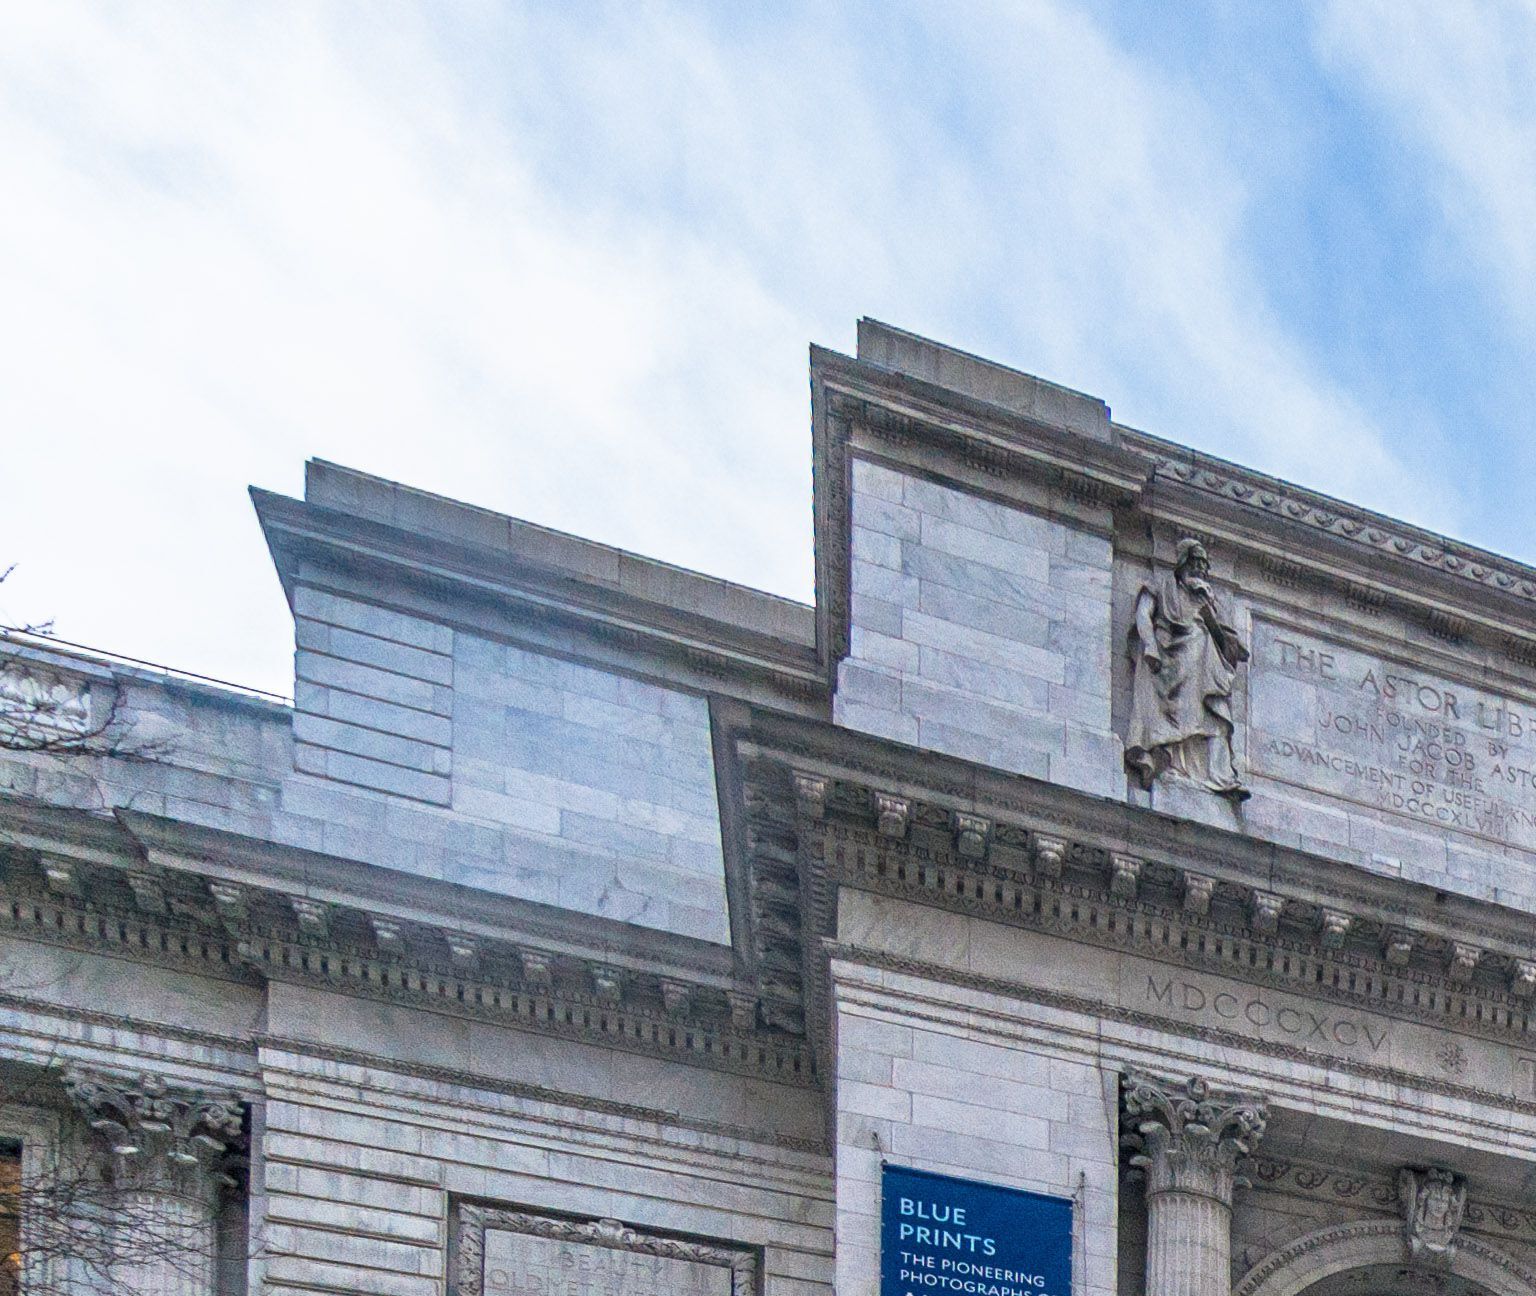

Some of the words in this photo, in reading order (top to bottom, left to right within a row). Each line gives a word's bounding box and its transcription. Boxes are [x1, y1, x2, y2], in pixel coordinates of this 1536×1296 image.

[1274, 638, 1335, 680] THE
[1359, 669, 1460, 719] ASTOR
[1318, 712, 1384, 744] JOHN
[1398, 735, 1476, 770] JACOB
[1378, 708, 1466, 747] FOUNDED
[1488, 742, 1508, 758] BY
[1267, 740, 1406, 794] ADVANCEMENT
[1411, 780, 1436, 796] OF
[1443, 787, 1504, 818] USEFUL
[1400, 755, 1435, 779] FOR
[1448, 768, 1484, 793] THE
[1147, 975, 1389, 1053] MDCCCXCV
[900, 1197, 966, 1226] BLUE
[900, 1224, 996, 1256] PRINTS
[489, 1269, 543, 1291] OLD
[560, 1251, 663, 1281] BEAUTY
[901, 1251, 938, 1269] THE
[942, 1256, 1046, 1288] PIONEERING
